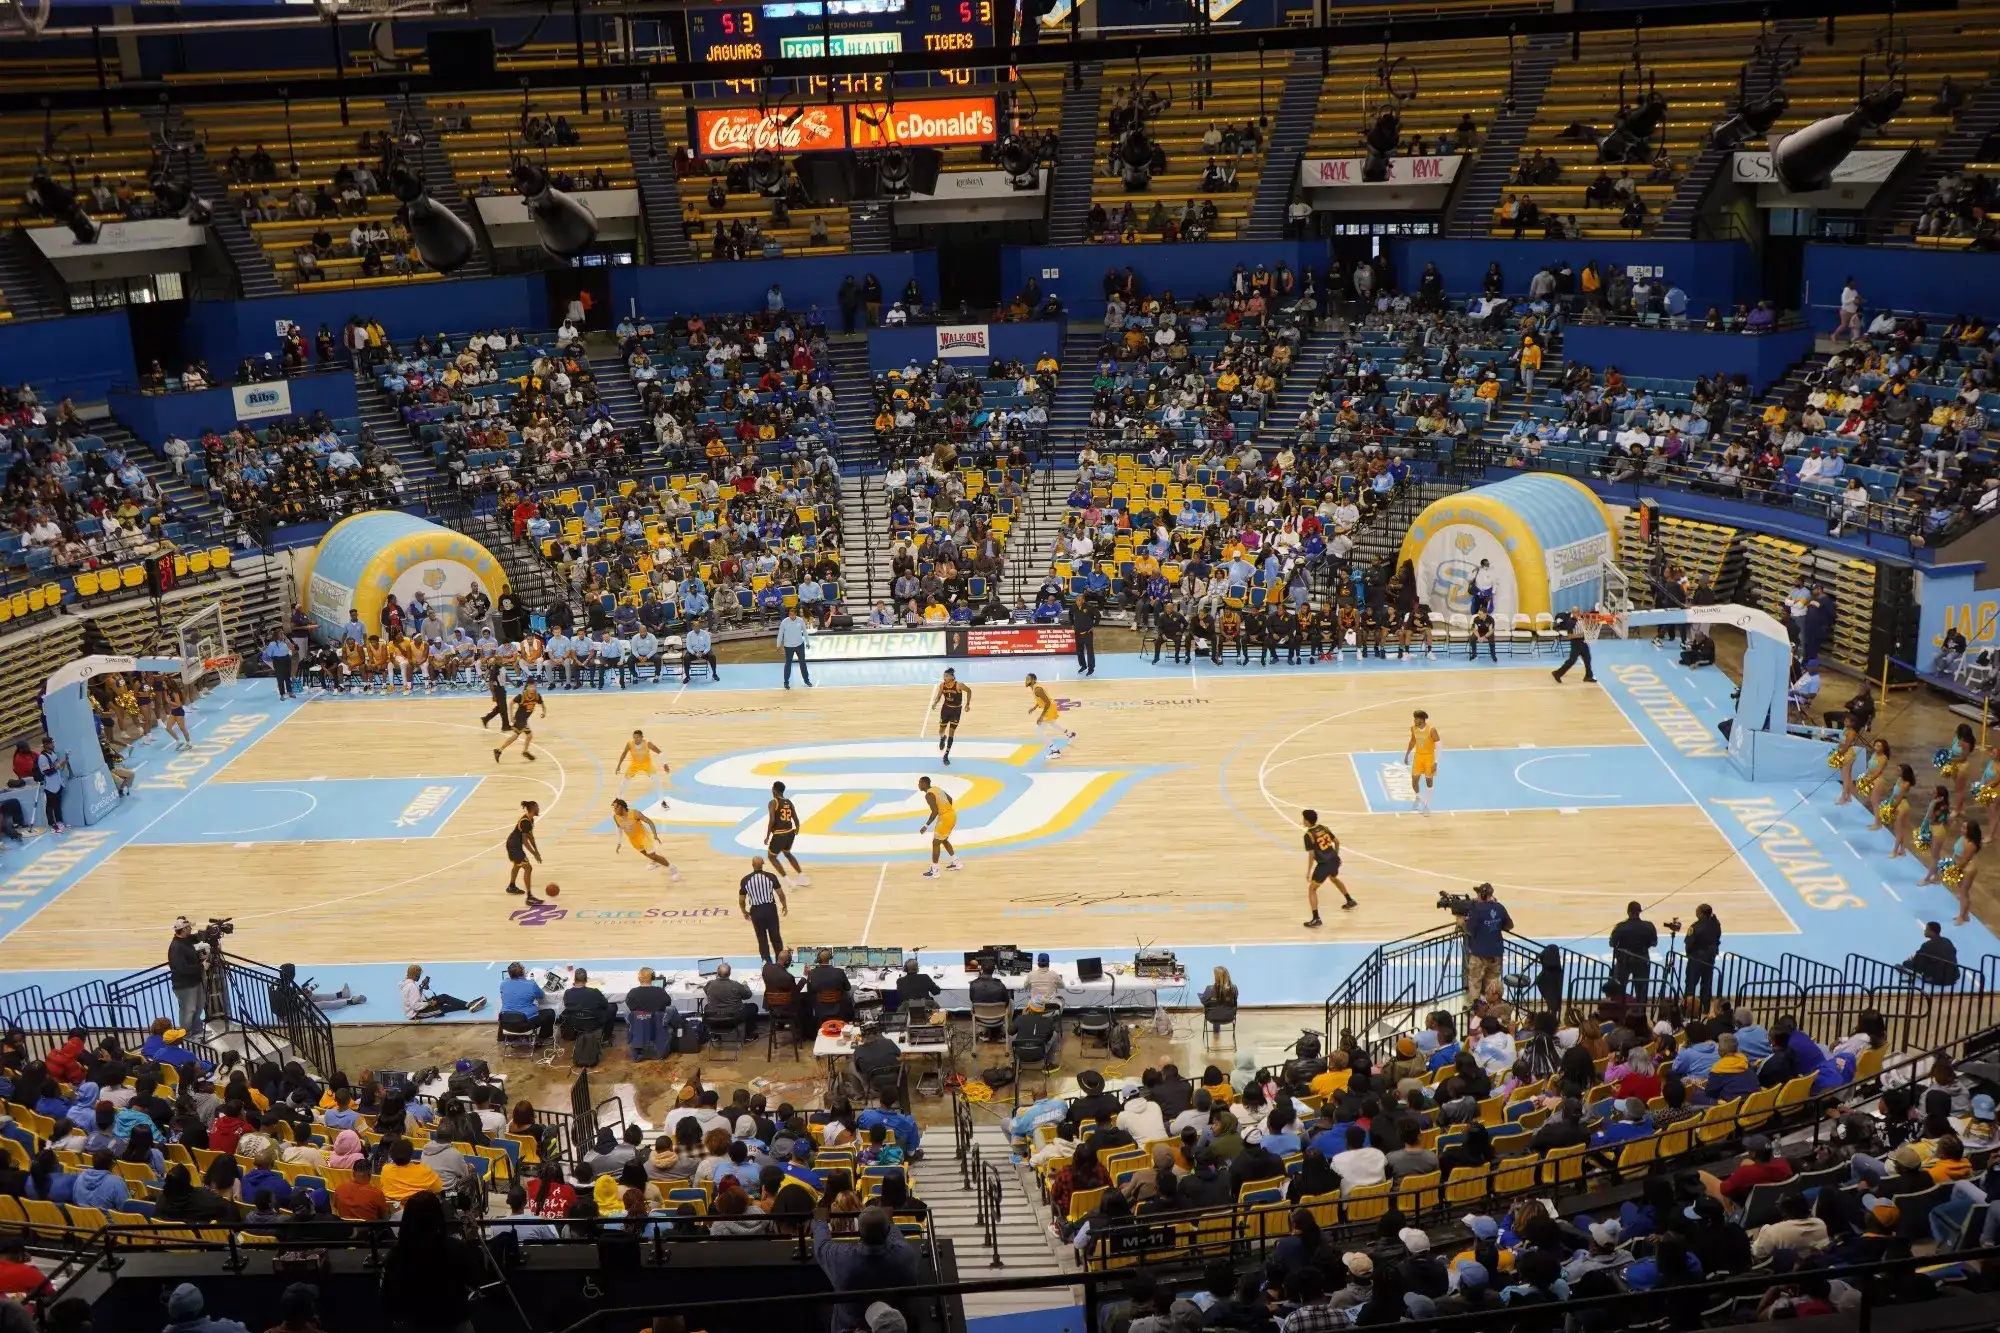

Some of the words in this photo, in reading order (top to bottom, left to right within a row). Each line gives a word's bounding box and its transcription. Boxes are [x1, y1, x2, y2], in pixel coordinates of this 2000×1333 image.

[960, 1, 971, 22] 5
[981, 1, 991, 21] 3
[722, 13, 734, 34] 5
[742, 12, 753, 33] 3
[847, 38, 895, 55] HEALTH
[924, 33, 974, 51] TIGERS
[706, 43, 762, 61] JAGUARS
[853, 107, 994, 144] McDonald's
[249, 392, 275, 404] Ribs
[1692, 607, 1721, 616] SPALDING
[1609, 663, 1730, 759] SOUTHERN
[135, 712, 270, 790] JAGUARS
[779, 808, 792, 822] 32
[1316, 833, 1332, 851] 23
[1709, 796, 1868, 911] JAGUARS
[576, 906, 731, 919] CareSouth
[1122, 1233, 1164, 1248] M-11
